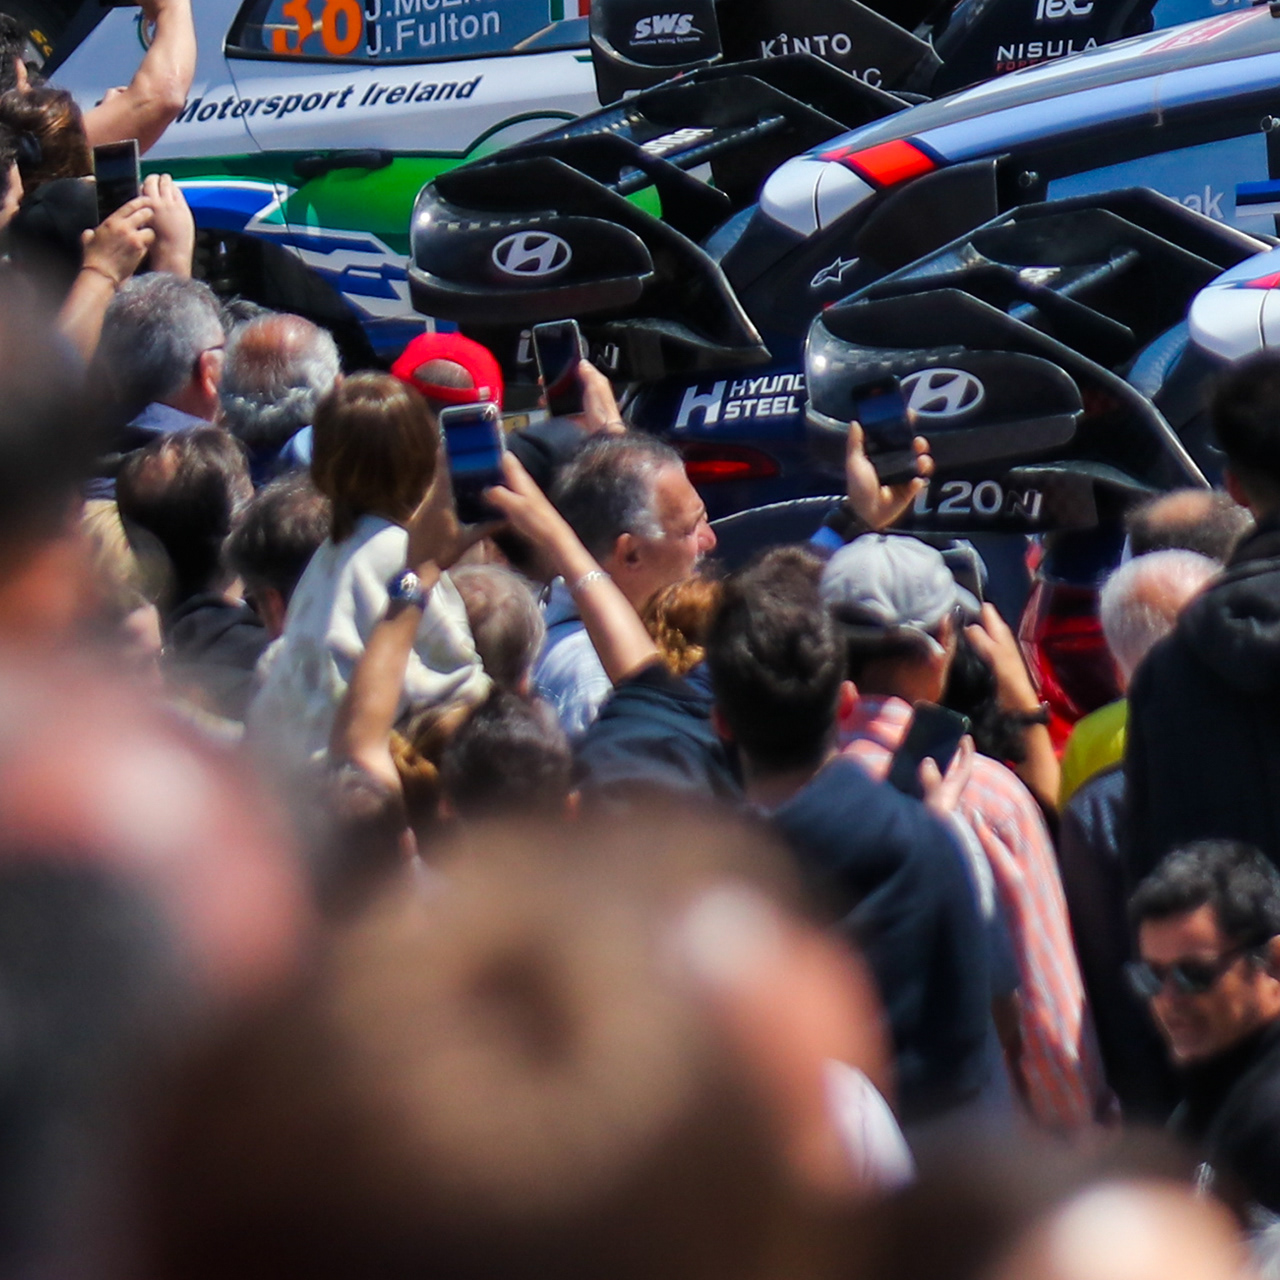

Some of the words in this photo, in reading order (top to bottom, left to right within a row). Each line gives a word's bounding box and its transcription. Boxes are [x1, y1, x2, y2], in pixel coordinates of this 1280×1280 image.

[366, 9, 501, 57] J.Fulton
[634, 13, 696, 39] SWS
[360, 75, 484, 108] Ireland
[729, 373, 806, 398] HYUN
[724, 396, 800, 420] STEEL
